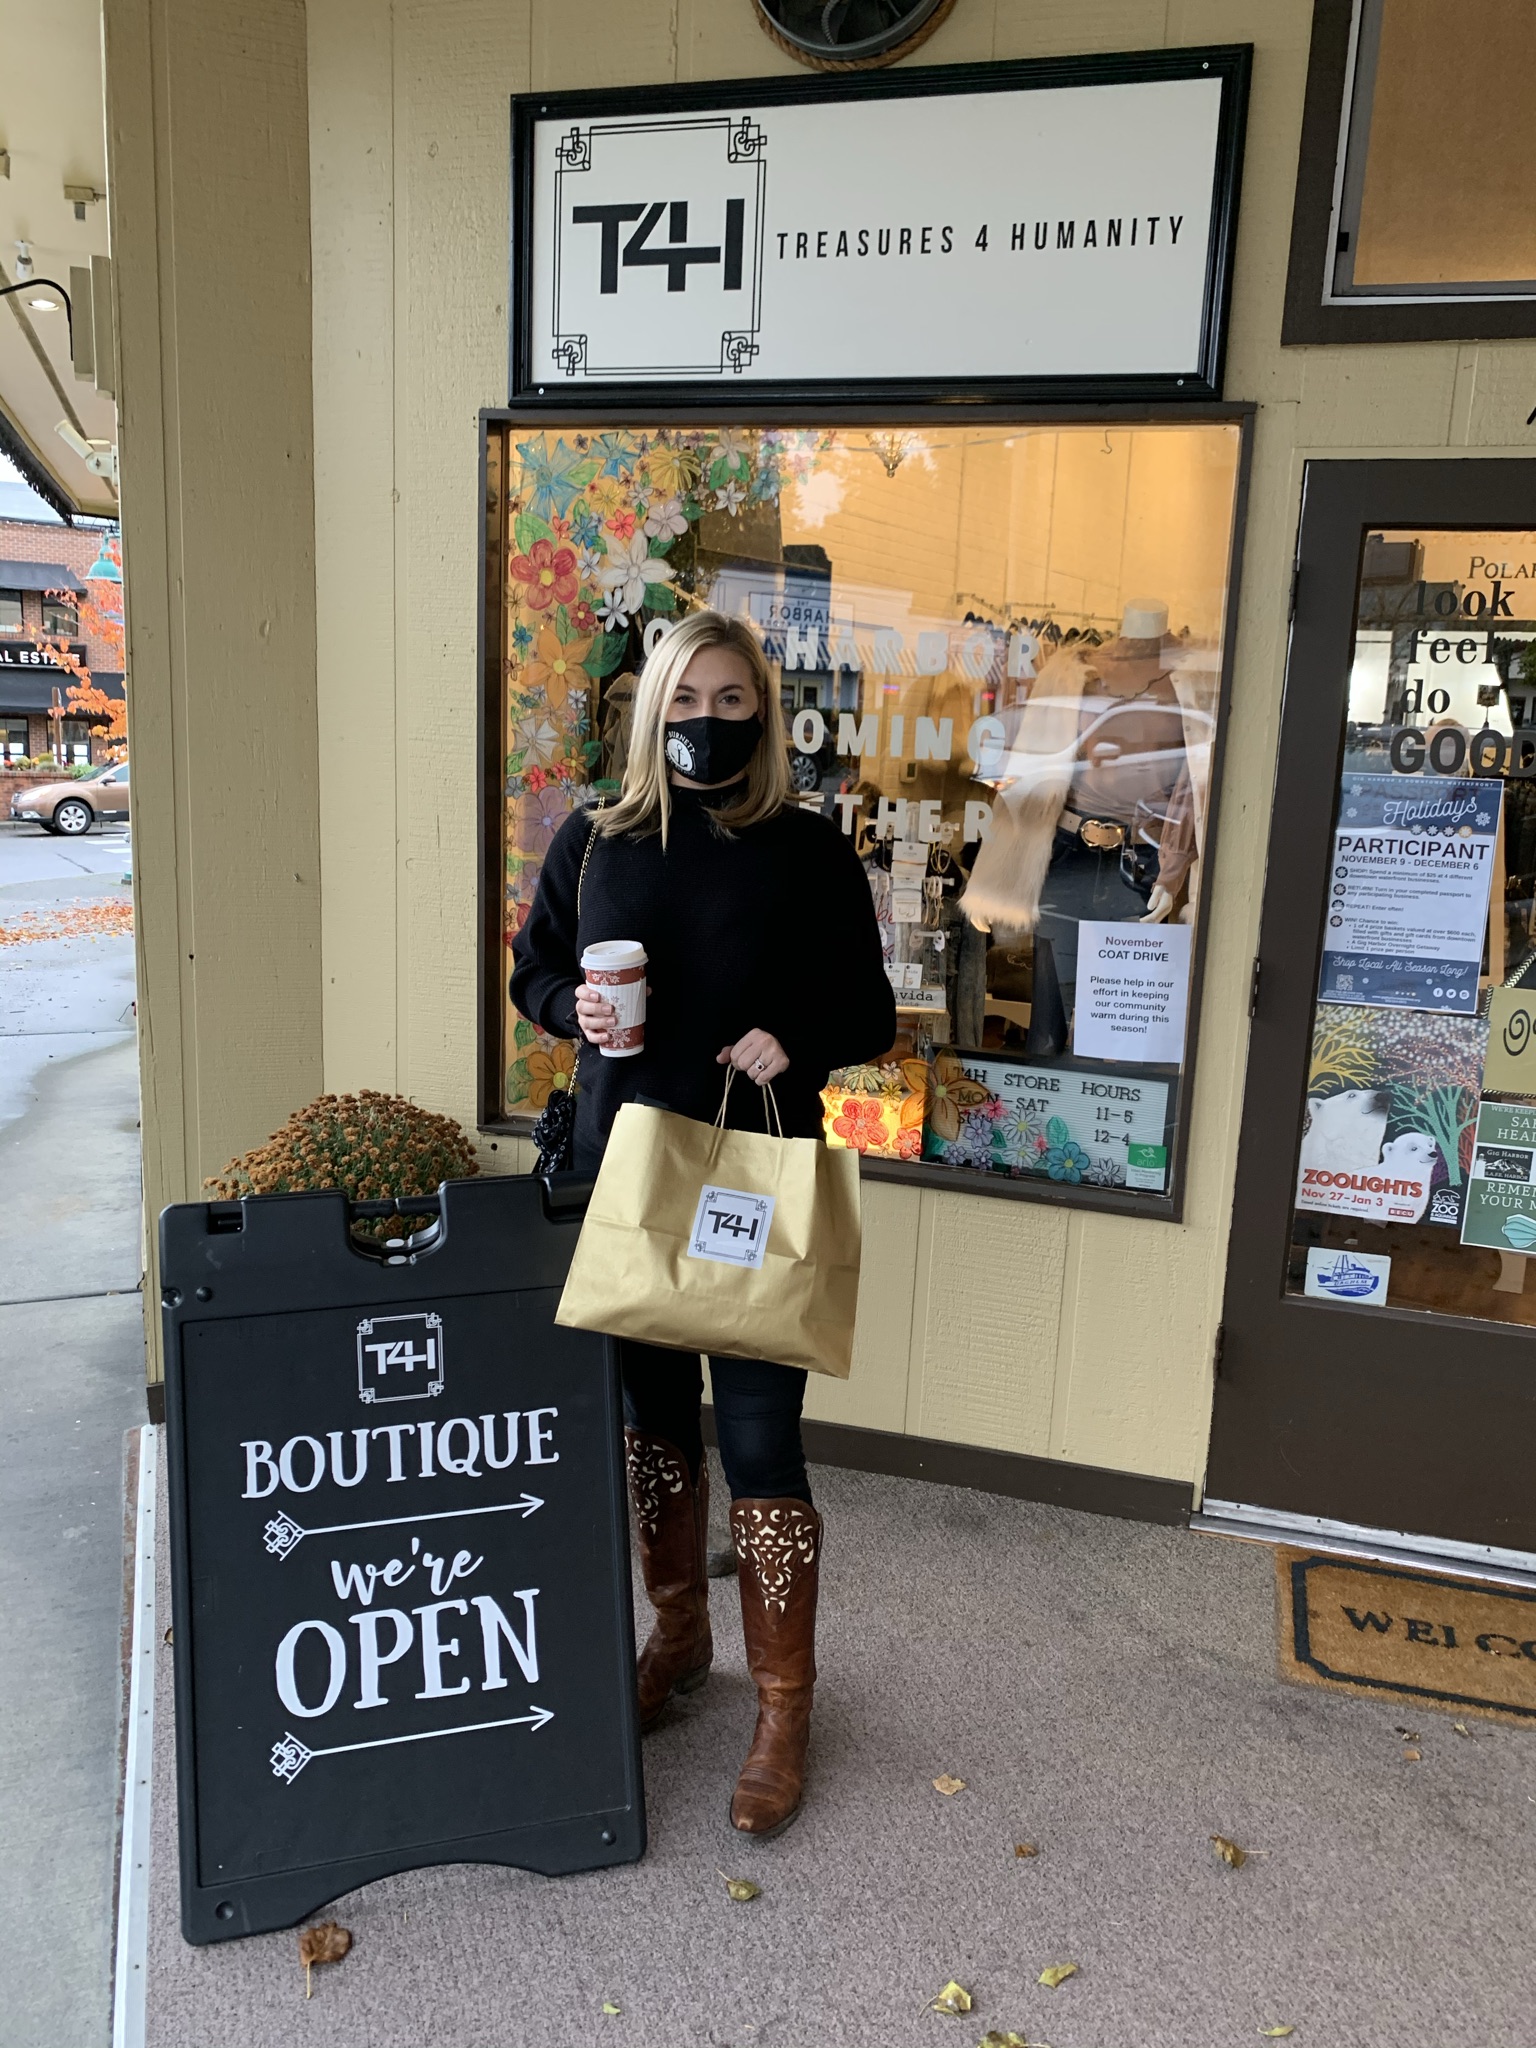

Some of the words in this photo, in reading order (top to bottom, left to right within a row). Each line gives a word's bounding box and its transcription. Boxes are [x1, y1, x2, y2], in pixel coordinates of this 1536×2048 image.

[572, 198, 746, 294] T4H
[776, 225, 956, 260] TREASURES
[974, 224, 989, 253] 4
[1010, 215, 1187, 252] HUMANITY
[1414, 580, 1515, 617] look
[785, 625, 1040, 679] HARBOR
[1406, 628, 1496, 665] feel
[1400, 679, 1451, 714] do
[668, 731, 696, 753] BURNETT
[792, 711, 1006, 766] OMING
[1390, 728, 1536, 778] GOOD
[1383, 796, 1478, 827] Holidays
[1338, 836, 1490, 860] PARTICIPANT
[1341, 854, 1397, 866] NOVEMBER
[1399, 858, 1406, 866] 9
[1413, 859, 1471, 870] DECEMBER
[1472, 862, 1479, 871] 6
[1105, 936, 1164, 948] November
[1098, 949, 1130, 960] COAT
[1133, 951, 1169, 962] DRIVE
[1333, 956, 1356, 969] Shop
[1359, 958, 1384, 970] Local
[1386, 960, 1403, 972] All
[1404, 961, 1438, 974] Season
[1440, 964, 1469, 979] Long!
[1090, 975, 1122, 985] Please
[1124, 977, 1144, 988] help
[1146, 979, 1155, 987] in
[1158, 980, 1174, 988] our
[1093, 988, 1118, 997] effort
[1121, 989, 1129, 998] in
[1131, 990, 1170, 1001] keeping
[1095, 1000, 1111, 1008] our
[1113, 1002, 1166, 1012] community
[1090, 1012, 1116, 1020] warm
[1119, 1012, 1149, 1023] during
[1152, 1015, 1170, 1023] this
[1110, 1024, 1147, 1034] season!
[1004, 1073, 1060, 1092] STORE
[1081, 1081, 1141, 1102] HOURS
[1491, 1104, 1514, 1113] WE'RE
[1137, 1158, 1155, 1167] arlo
[1302, 1168, 1422, 1198] ZOOLIGHTS
[1301, 1188, 1325, 1199] Nov
[1376, 1198, 1383, 1206] 3
[1431, 1203, 1458, 1215] ZOO
[1480, 1194, 1523, 1209] YOUR
[1390, 1209, 1413, 1217] BECU
[708, 1210, 759, 1241] T4H
[364, 1338, 436, 1375] T4H
[240, 1407, 560, 1499] BOUTIQUE
[330, 1537, 484, 1606] we're
[275, 1588, 540, 1718] OPEN
